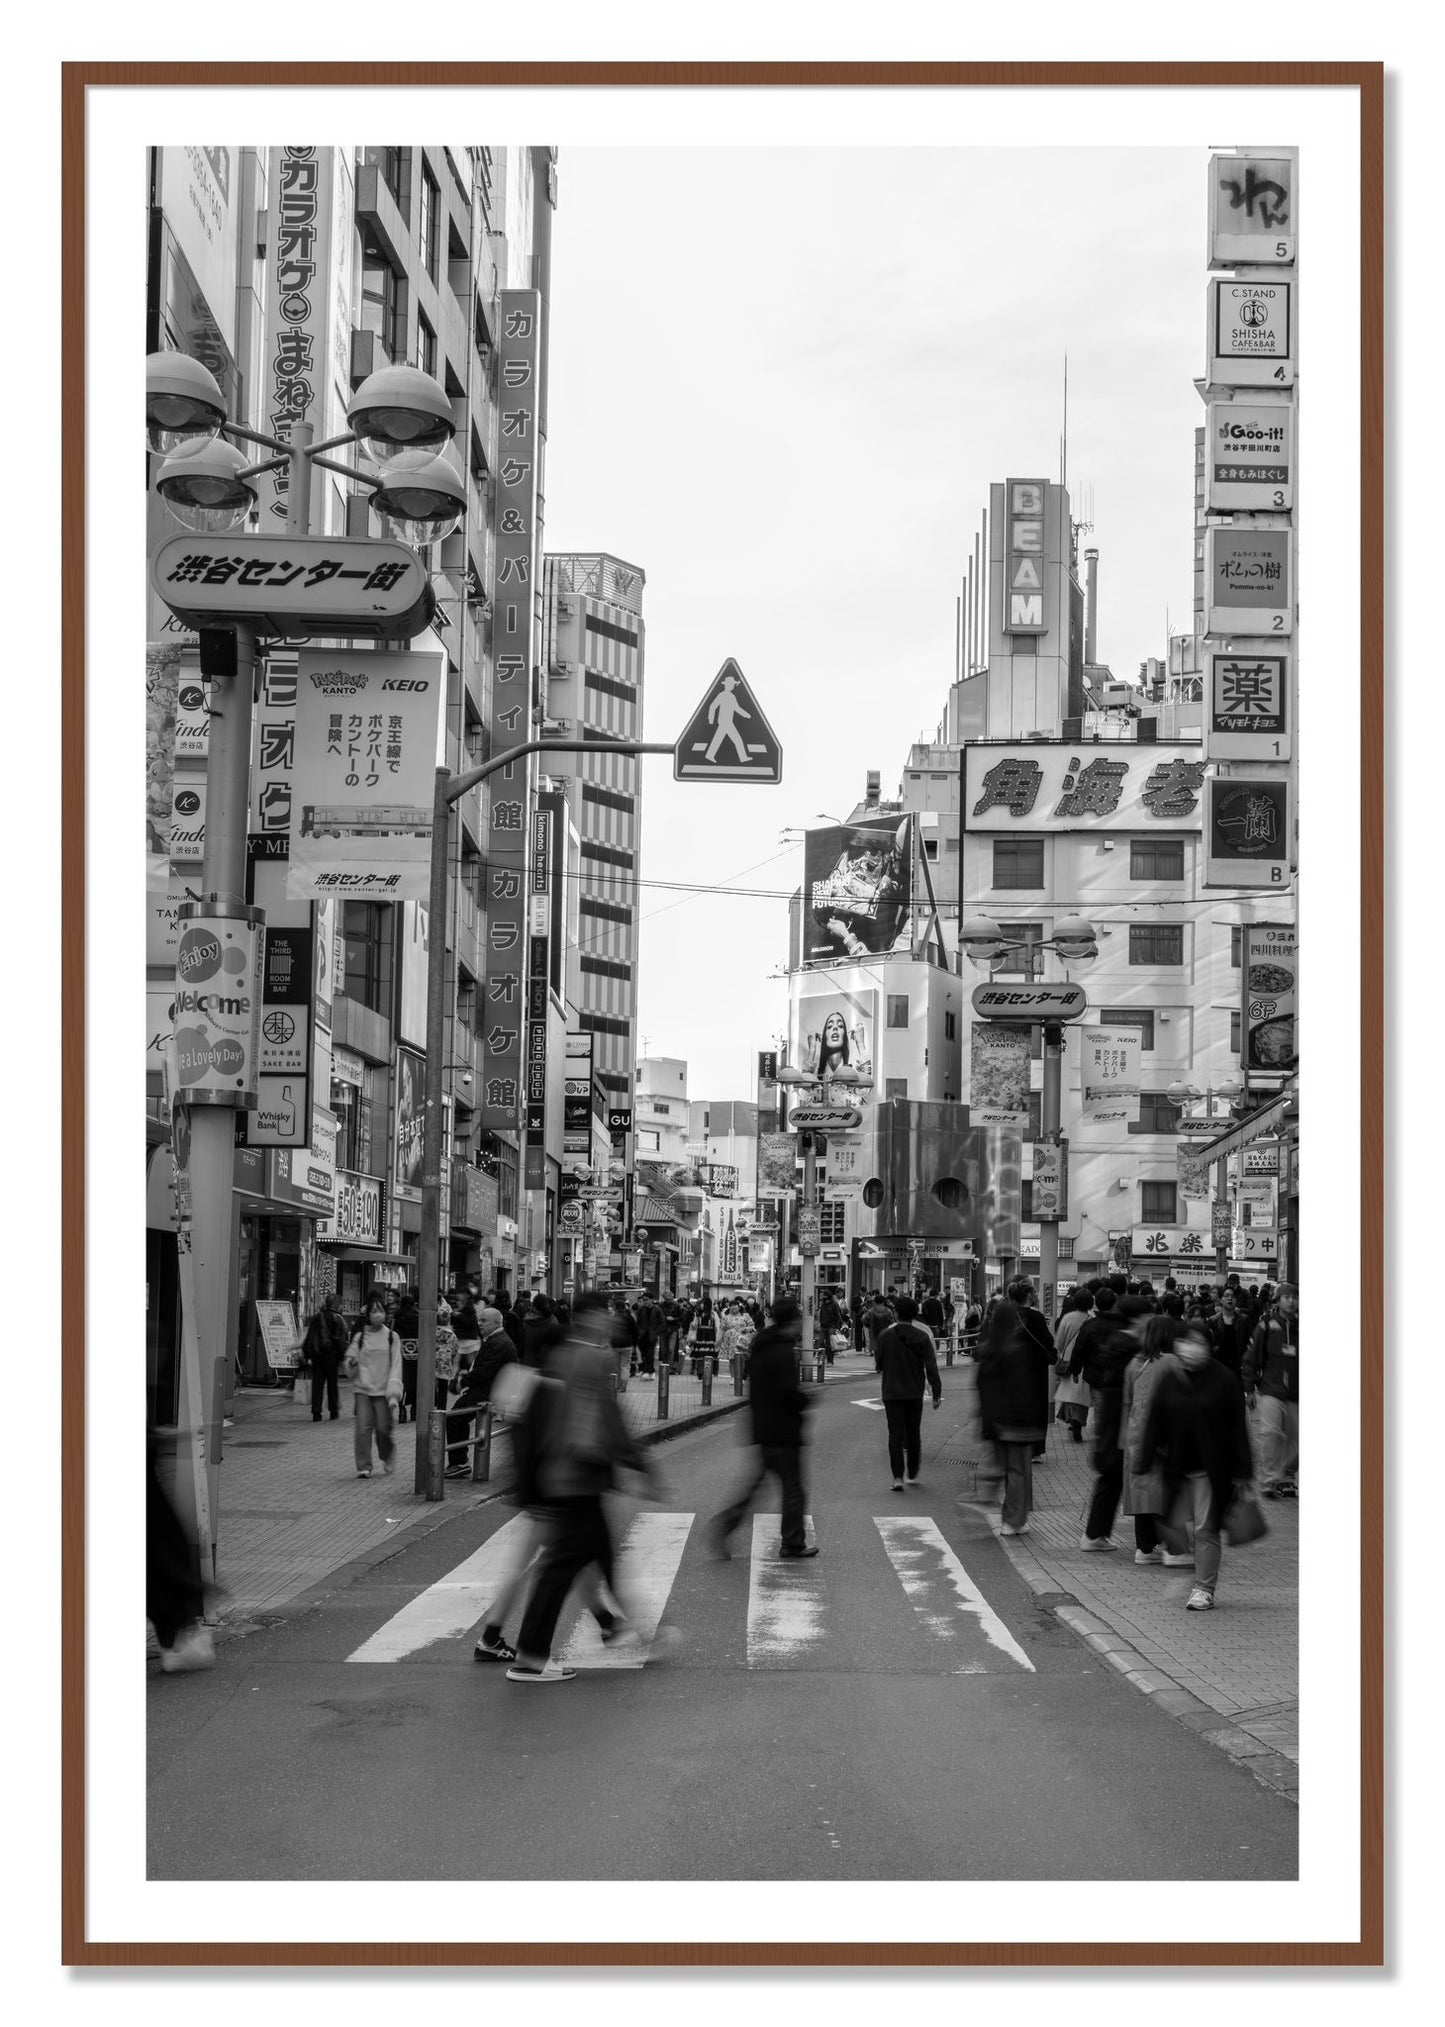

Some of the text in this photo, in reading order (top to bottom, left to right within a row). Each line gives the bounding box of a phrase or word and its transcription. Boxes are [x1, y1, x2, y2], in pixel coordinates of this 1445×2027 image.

[1275, 242, 1287, 257] 5
[1231, 288, 1276, 299] C.STAND
[1231, 328, 1276, 340] SHISHA
[1231, 339, 1276, 349] CAFE&BAR
[1273, 366, 1286, 381] 4
[1230, 424, 1284, 441] Goo-it!
[1223, 443, 1281, 453] 渋谷宇田川町店
[1218, 468, 1285, 480] 全身もみほぐし
[1273, 491, 1285, 507] 3
[1011, 483, 1043, 625] BEAM
[166, 555, 411, 592] 渋谷センター街
[1272, 616, 1284, 631] 2
[322, 686, 357, 695] KANTO
[381, 679, 429, 692] KEIO
[1222, 663, 1273, 713] 薬
[1217, 715, 1278, 730] マツモトキヨシ
[327, 714, 343, 756] 冒険へ
[345, 714, 363, 787] カントーの
[386, 715, 403, 774] 京王線で
[1271, 741, 1280, 756] 1
[175, 846, 200, 855] 渋谷店
[536, 815, 546, 889] kimono hearts
[315, 873, 401, 886] 渋谷センター街
[1270, 866, 1283, 882] B
[179, 941, 218, 975] Enjoy
[270, 947, 292, 955] THIRD
[270, 975, 291, 983] ROOM
[175, 990, 251, 1015] Welcome
[979, 991, 1080, 1005] 渋谷センター街
[1249, 1000, 1278, 1020] 6F
[192, 1047, 222, 1067] Lovely
[223, 1048, 243, 1061] Day!
[258, 1111, 291, 1126] Whisky
[610, 1115, 630, 1126] GU
[792, 1112, 853, 1122] 渋谷センター街
[257, 1121, 277, 1130] Bank
[1145, 1232, 1203, 1253] 兆楽
[727, 1230, 735, 1272] BEER
